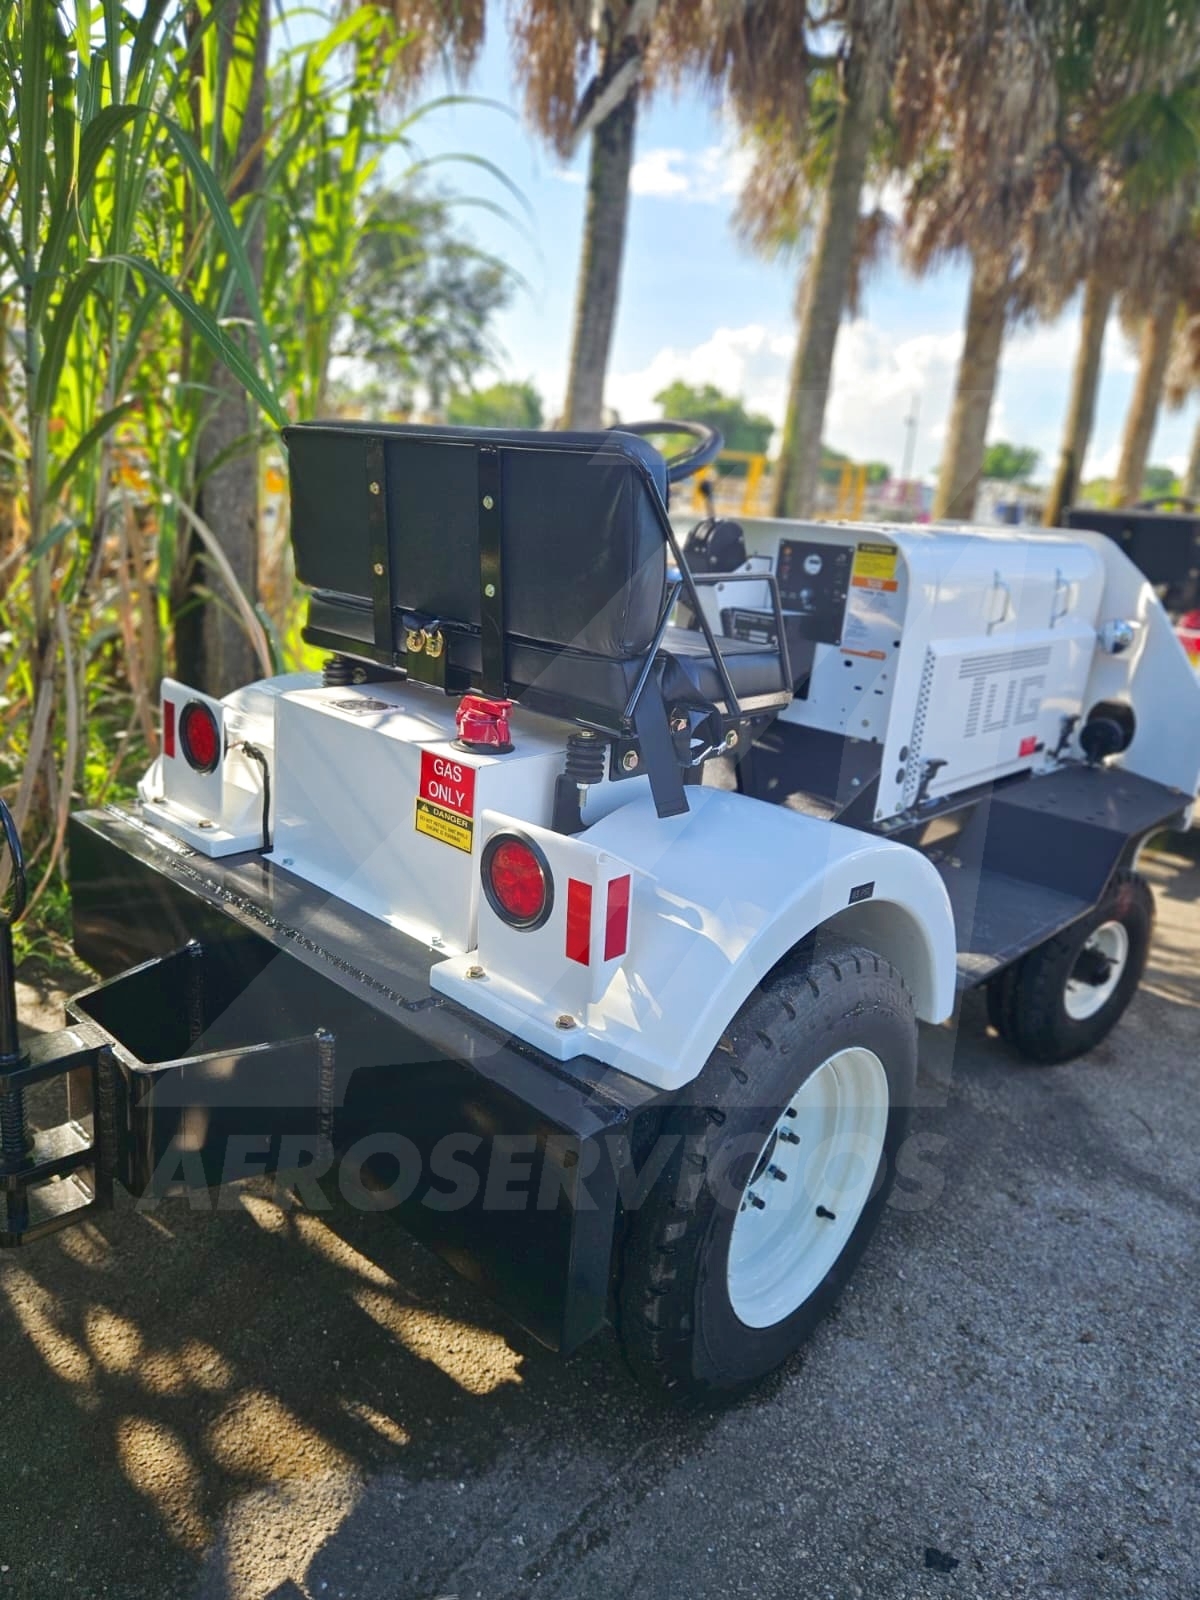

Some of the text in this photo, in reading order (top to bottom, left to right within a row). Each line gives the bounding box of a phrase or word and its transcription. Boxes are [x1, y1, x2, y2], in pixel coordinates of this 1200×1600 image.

[958, 646, 1052, 738] TUG
[433, 759, 462, 783] GAS
[428, 781, 465, 808] ONLY
[433, 808, 468, 828] DANGER
